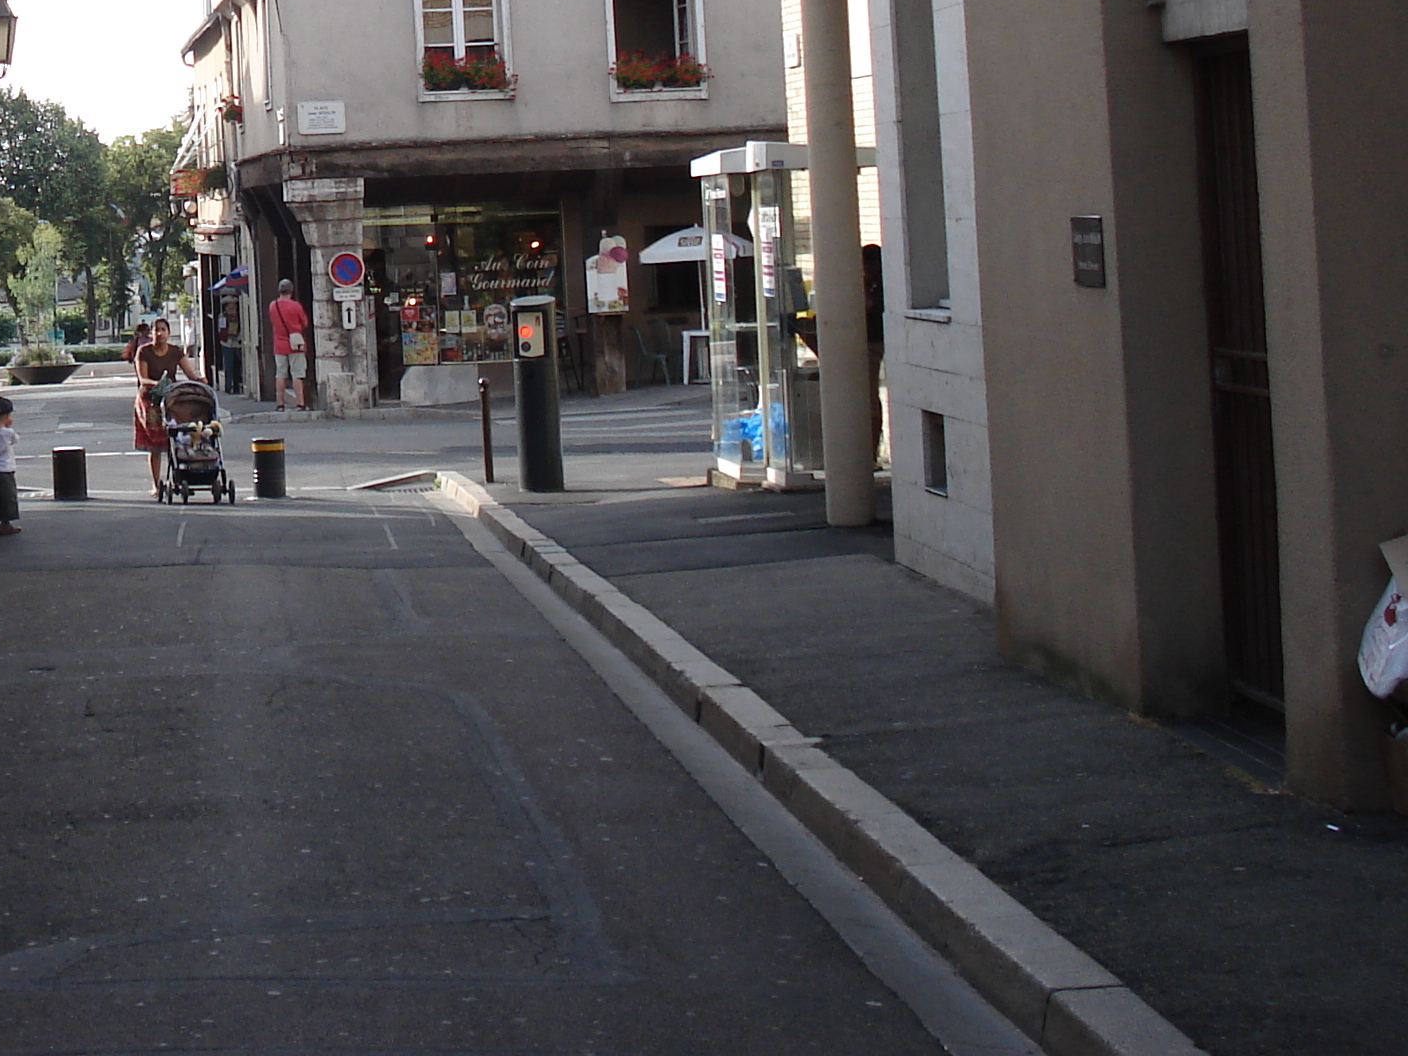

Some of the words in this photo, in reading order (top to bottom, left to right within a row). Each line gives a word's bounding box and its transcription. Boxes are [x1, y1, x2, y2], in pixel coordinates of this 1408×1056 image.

[474, 255, 502, 272] Au
[513, 253, 550, 270] Coin
[467, 270, 555, 291] Gourmand
